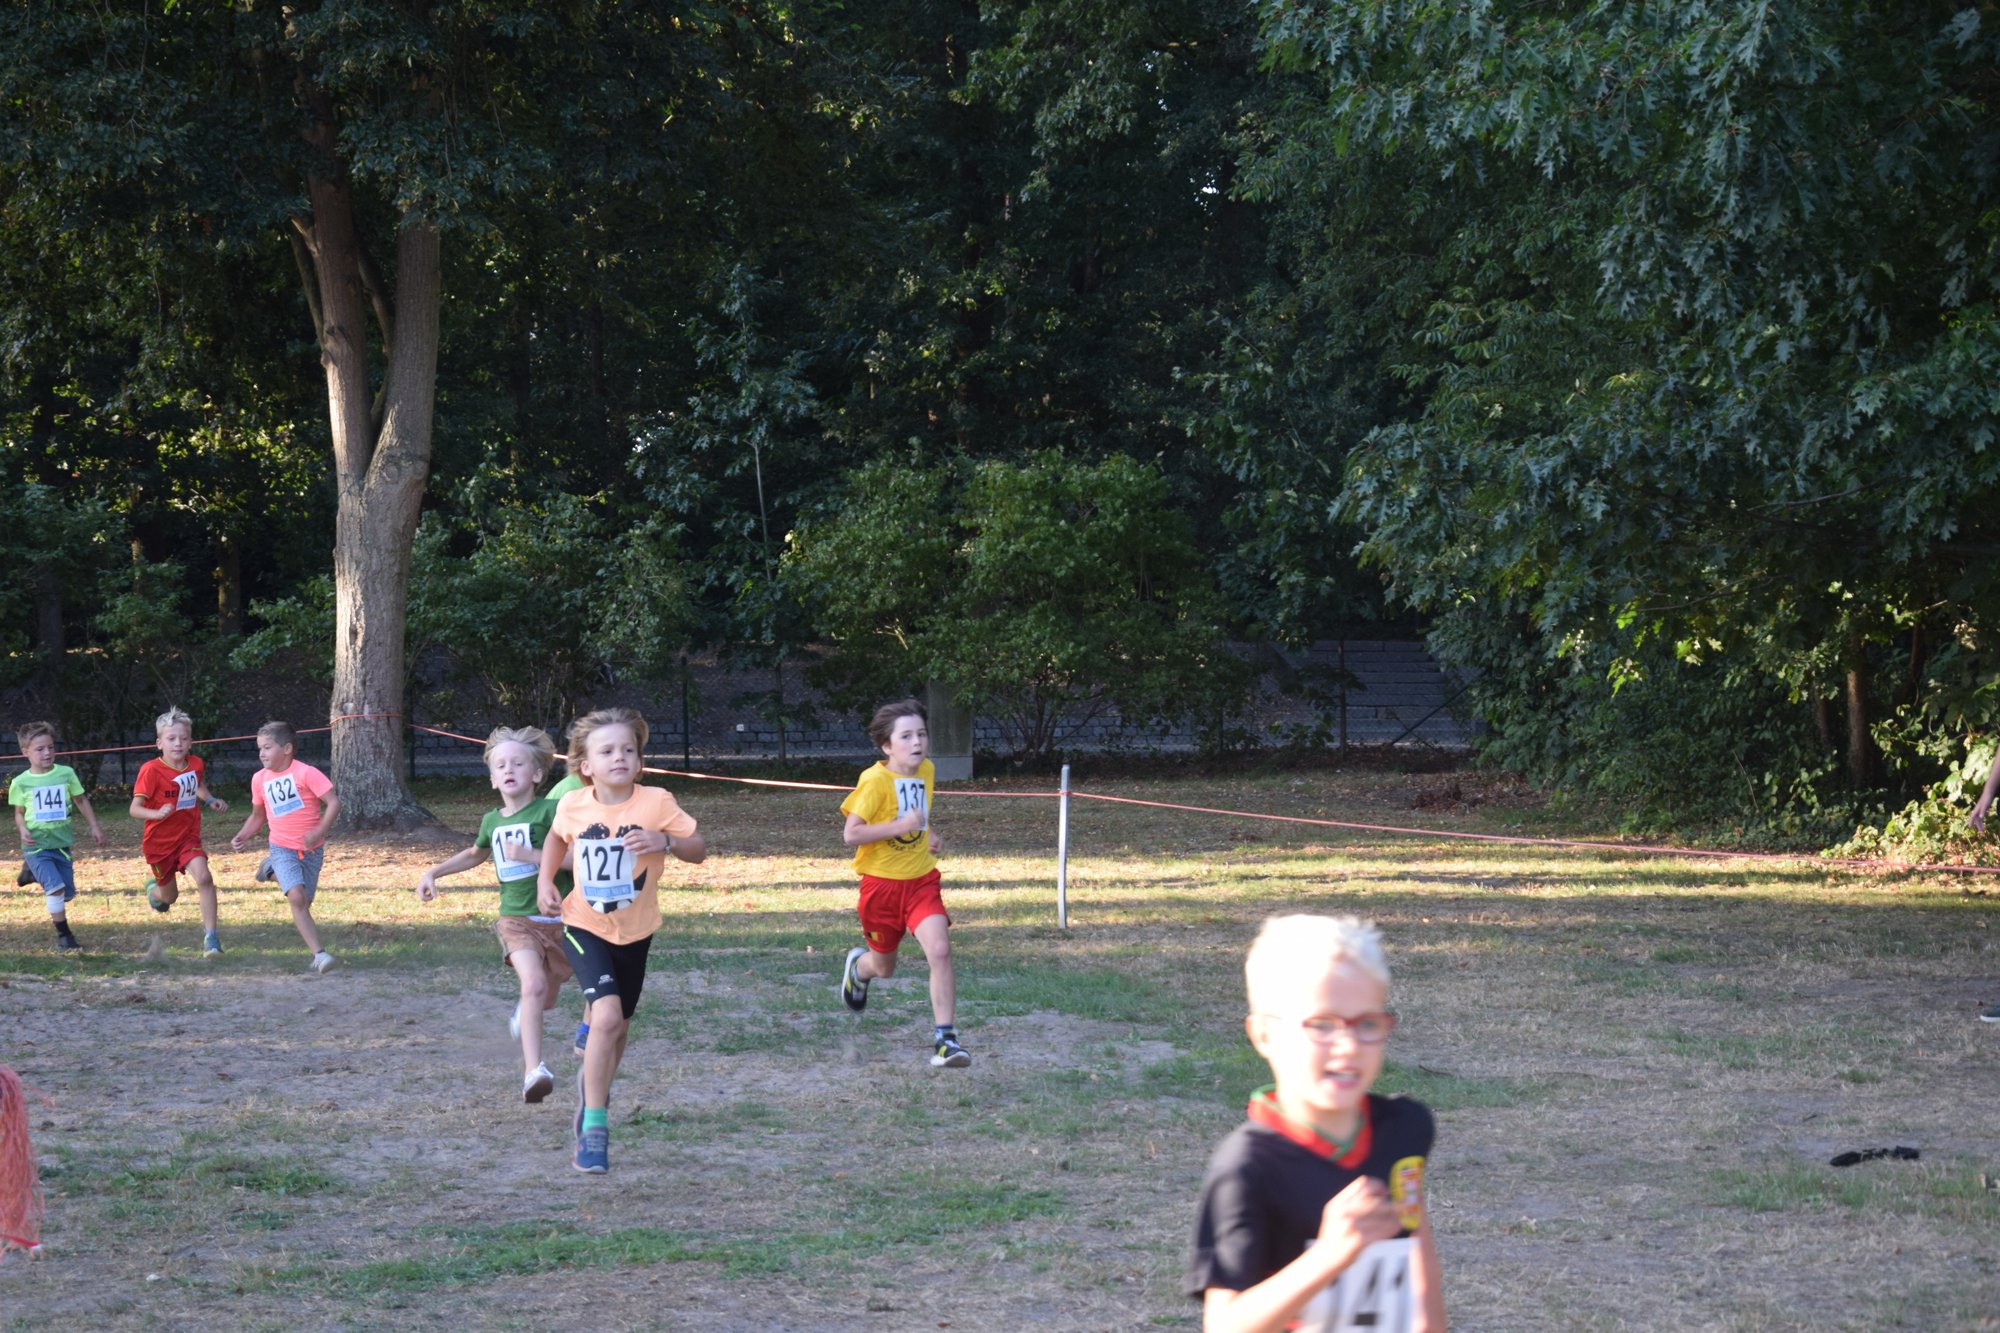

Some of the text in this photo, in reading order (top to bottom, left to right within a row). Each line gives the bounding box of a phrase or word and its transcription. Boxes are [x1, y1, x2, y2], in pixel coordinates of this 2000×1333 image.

[35, 788, 63, 810] 144
[180, 775, 197, 798] 142
[268, 778, 296, 804] 132
[900, 783, 925, 811] 137
[582, 845, 624, 881] 127
